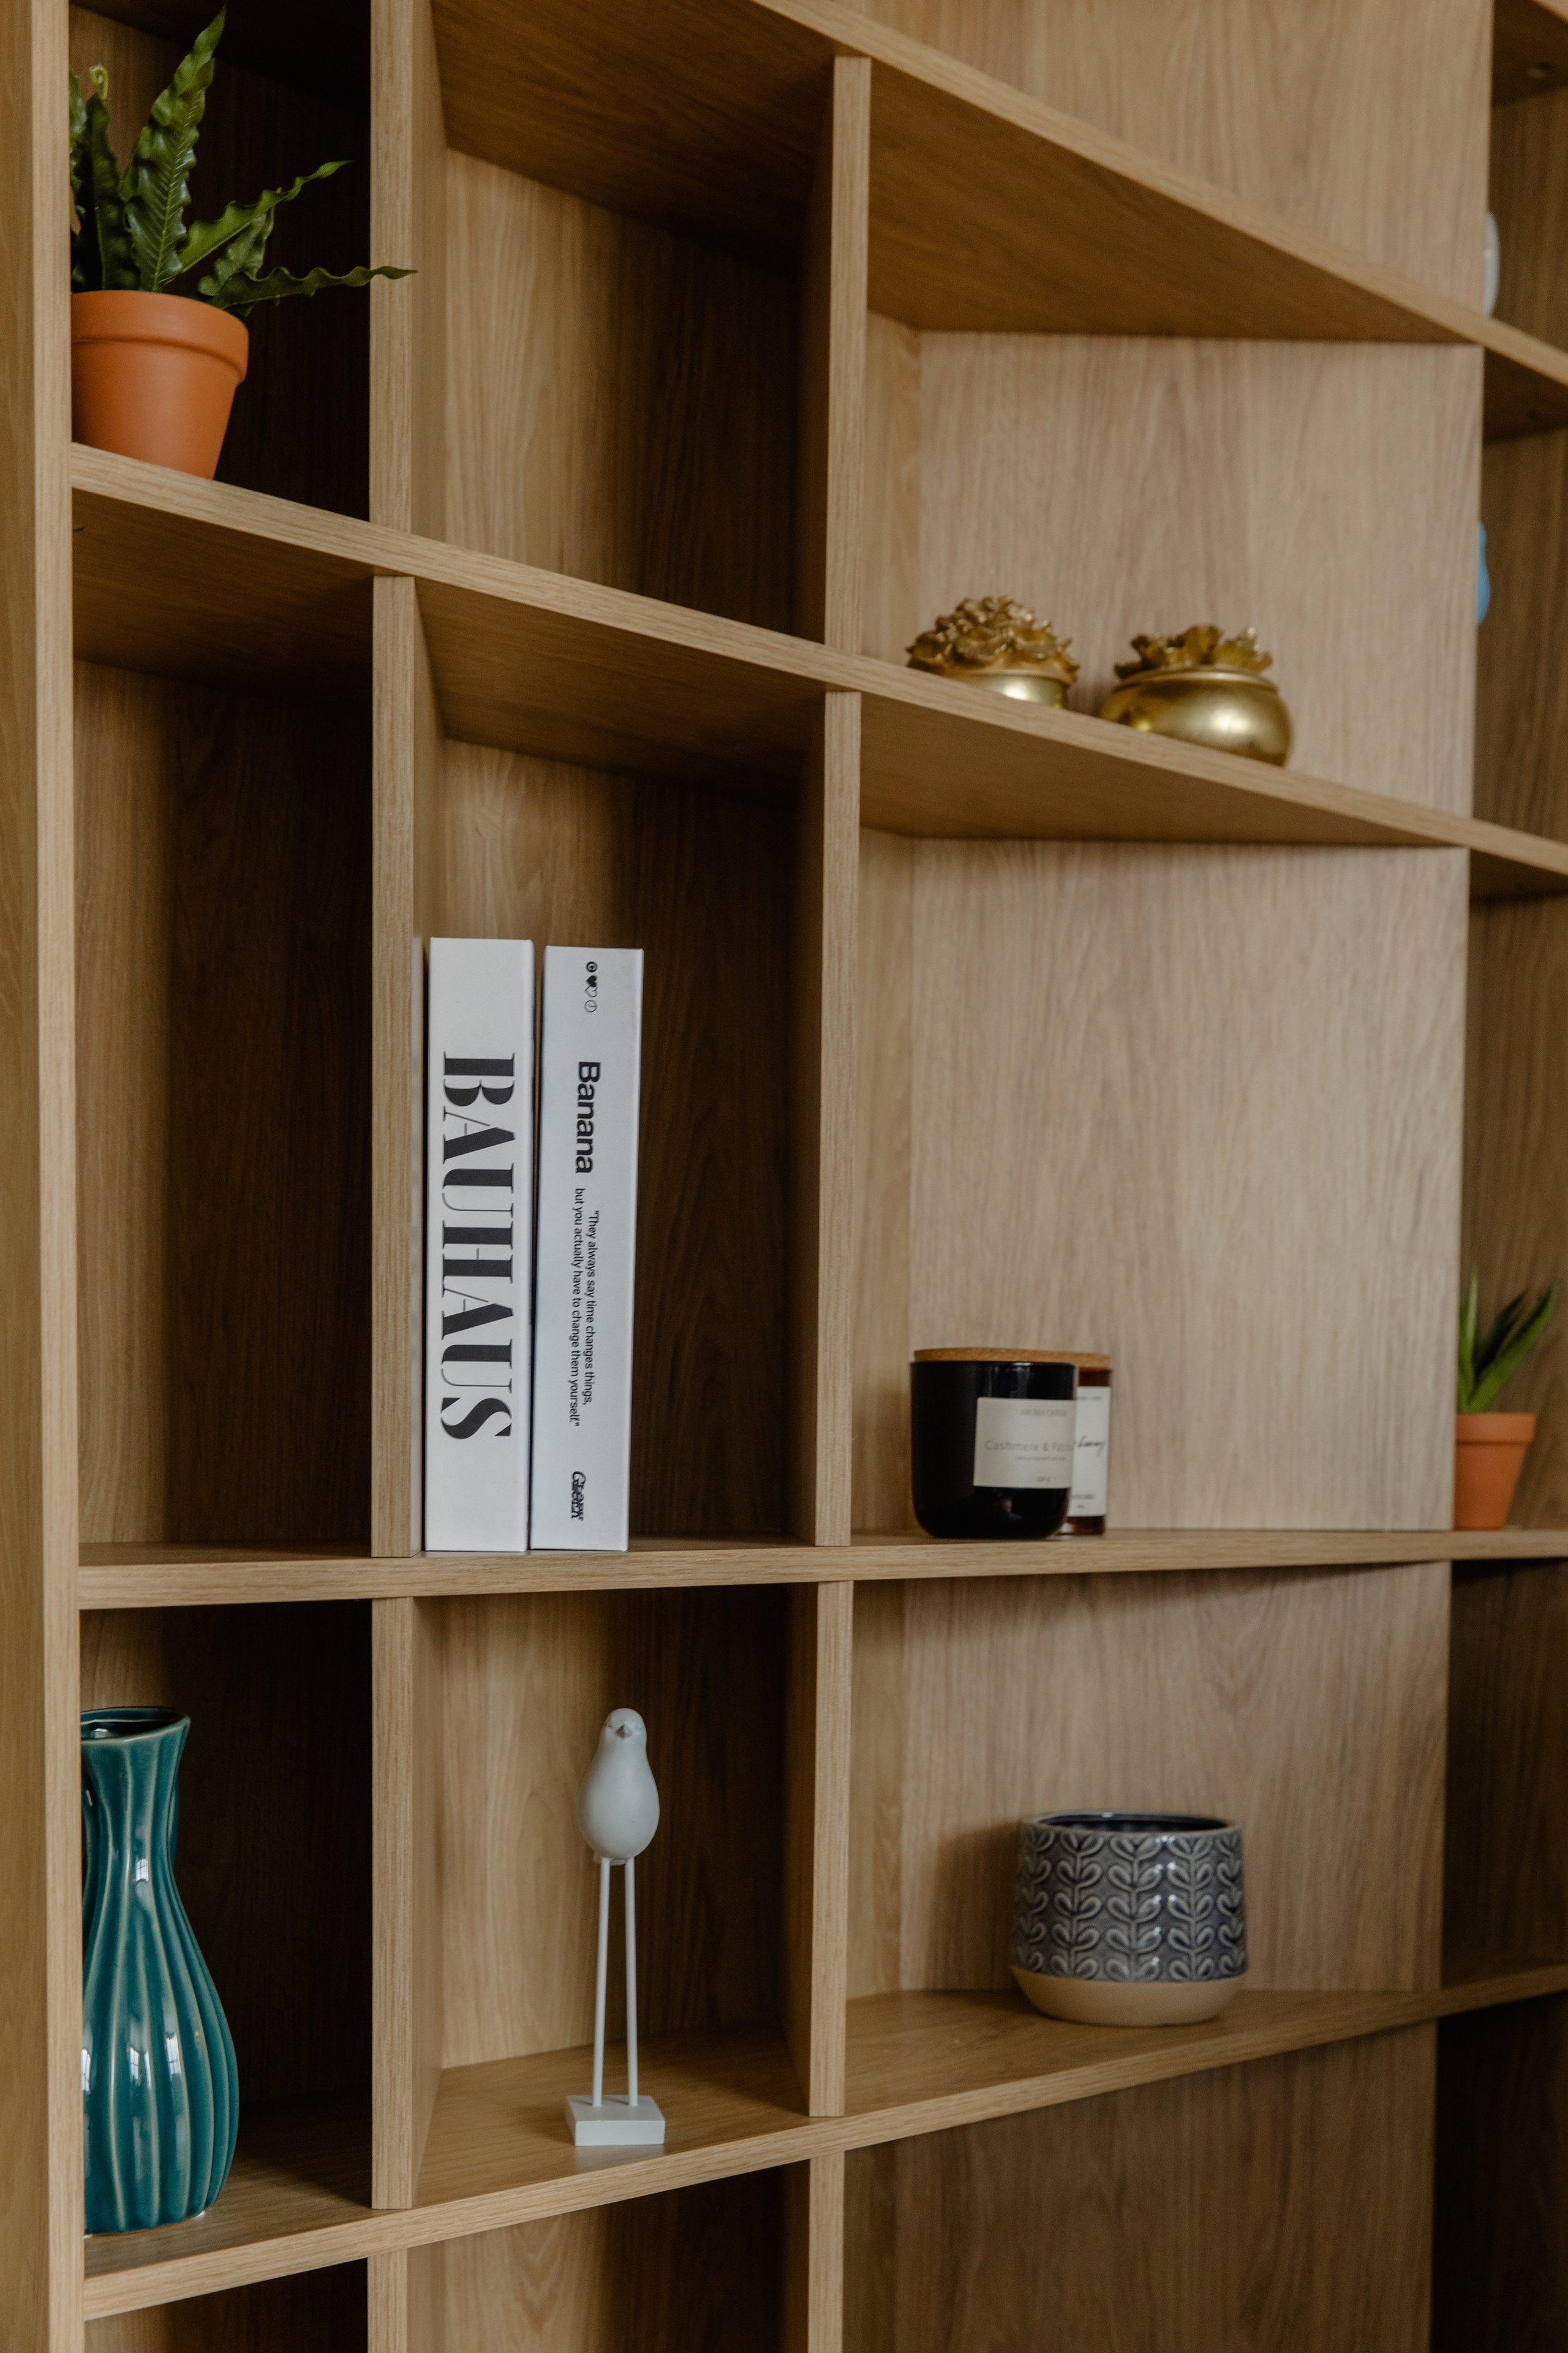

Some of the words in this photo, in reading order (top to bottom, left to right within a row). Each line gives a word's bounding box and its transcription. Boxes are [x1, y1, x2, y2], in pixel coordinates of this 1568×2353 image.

[575, 1060, 602, 1174] Banana
[575, 1187, 585, 1204] but
[571, 1207, 583, 1225] you
[586, 1210, 600, 1239] "They
[440, 1050, 516, 1440] BAUHAUS
[570, 1227, 584, 1268] actually
[584, 1241, 598, 1278] always
[571, 1271, 584, 1295] have
[584, 1280, 595, 1298] say
[571, 1297, 582, 1308] to
[586, 1300, 597, 1323] time
[569, 1310, 582, 1348] change
[582, 1325, 597, 1369] changes
[570, 1350, 582, 1377] them
[581, 1371, 595, 1405] things,
[568, 1379, 580, 1427] yourself."
[985, 1440, 1040, 1451] Cashmere
[1042, 1441, 1049, 1452] &
